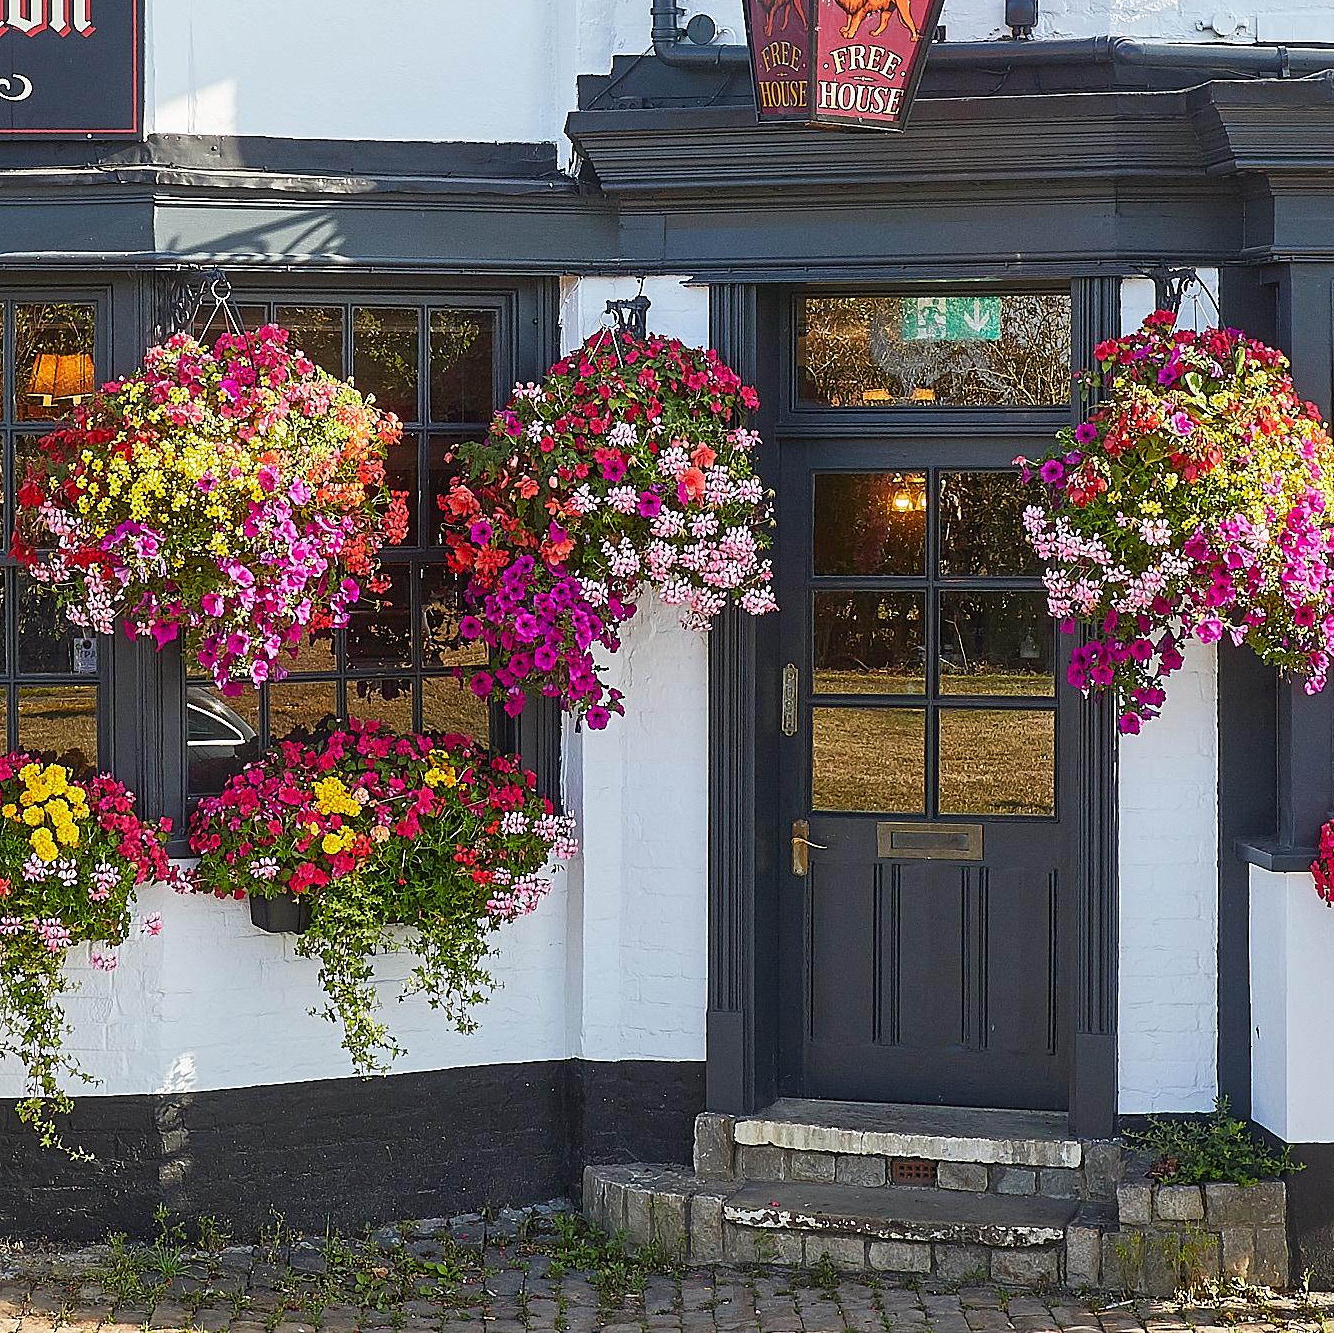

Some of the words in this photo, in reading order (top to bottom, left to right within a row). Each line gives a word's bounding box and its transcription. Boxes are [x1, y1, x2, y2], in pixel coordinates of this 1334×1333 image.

[761, 41, 802, 73] FREE
[830, 44, 903, 80] FREE
[759, 80, 808, 108] HOUSE
[818, 80, 905, 115] HOUSE
